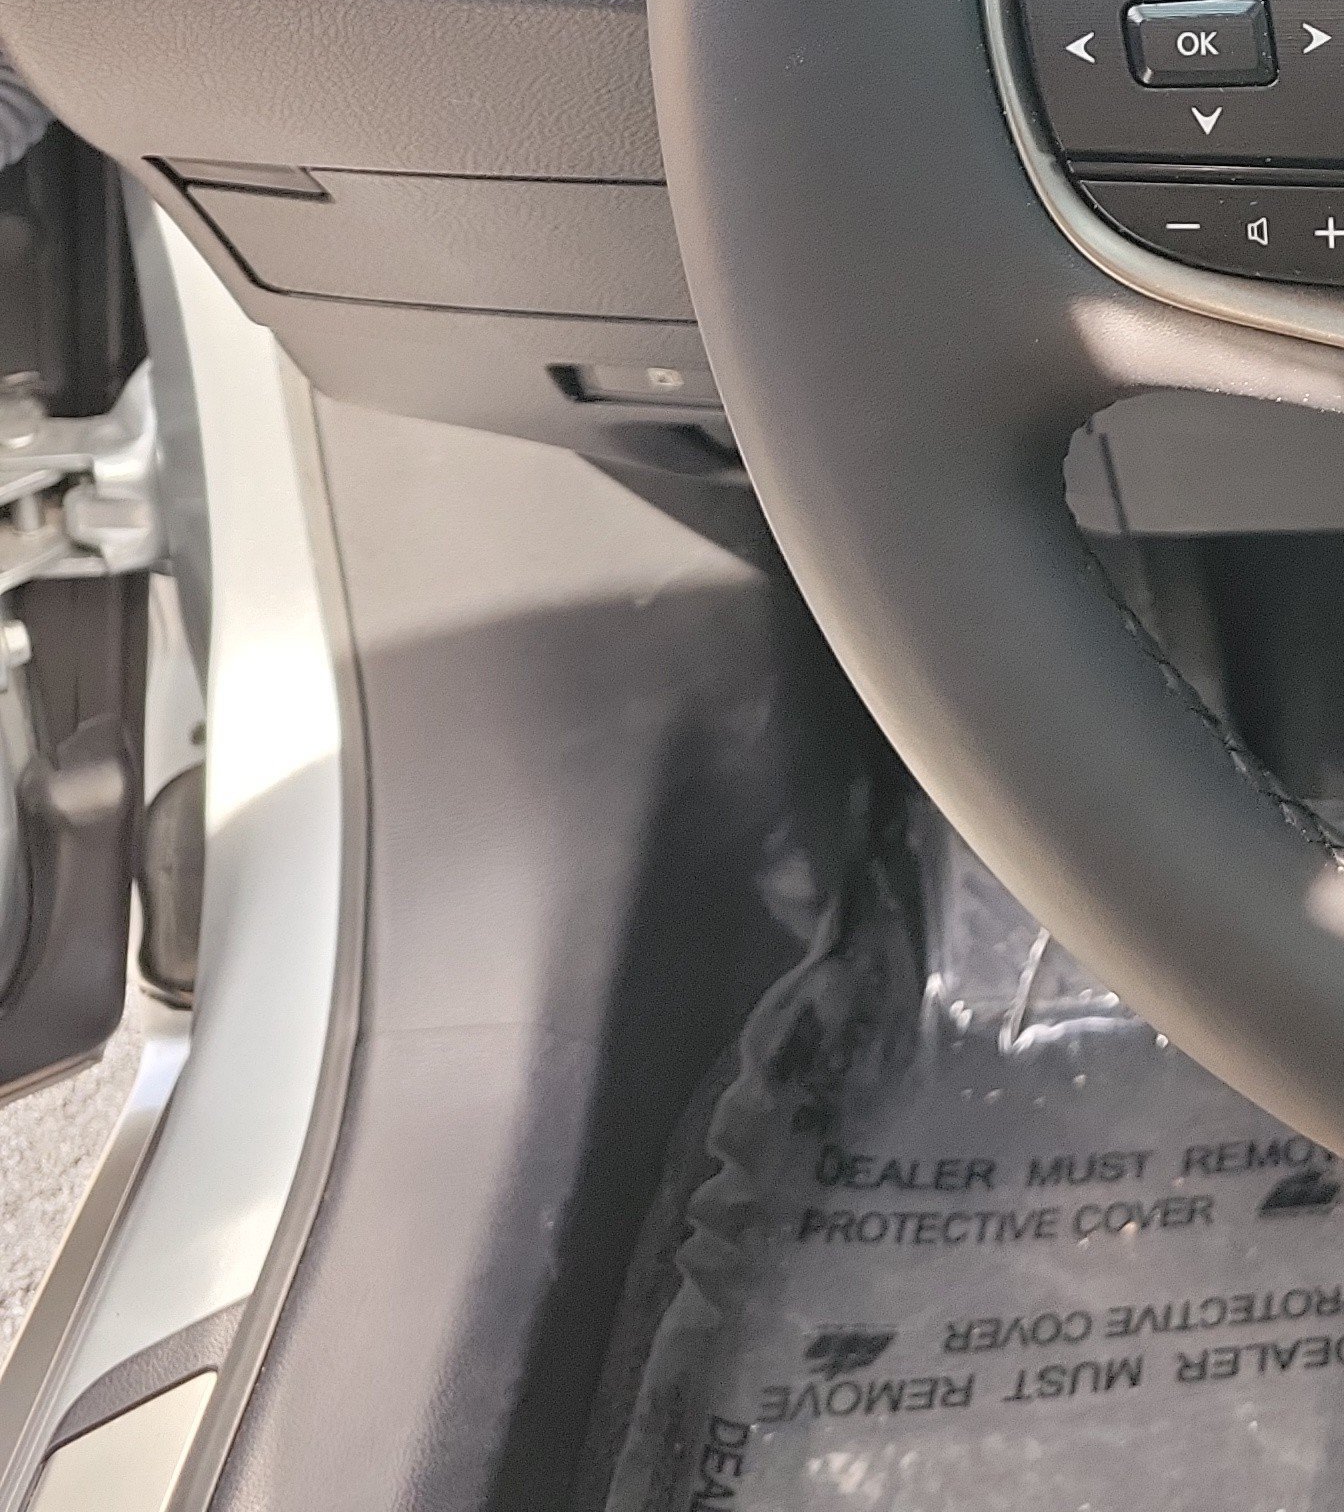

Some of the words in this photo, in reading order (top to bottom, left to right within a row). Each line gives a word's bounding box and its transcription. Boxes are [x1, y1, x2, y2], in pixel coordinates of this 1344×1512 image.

[1177, 31, 1219, 56] OK
[814, 1145, 998, 1190] DEALER
[1024, 1149, 1155, 1188] MUST
[797, 1205, 1060, 1249] PROTECTIVE
[1072, 1194, 1215, 1240] COVER
[941, 1308, 1095, 1355] COVER
[754, 1370, 979, 1426] REMOVE
[1003, 1352, 1145, 1404] MUST
